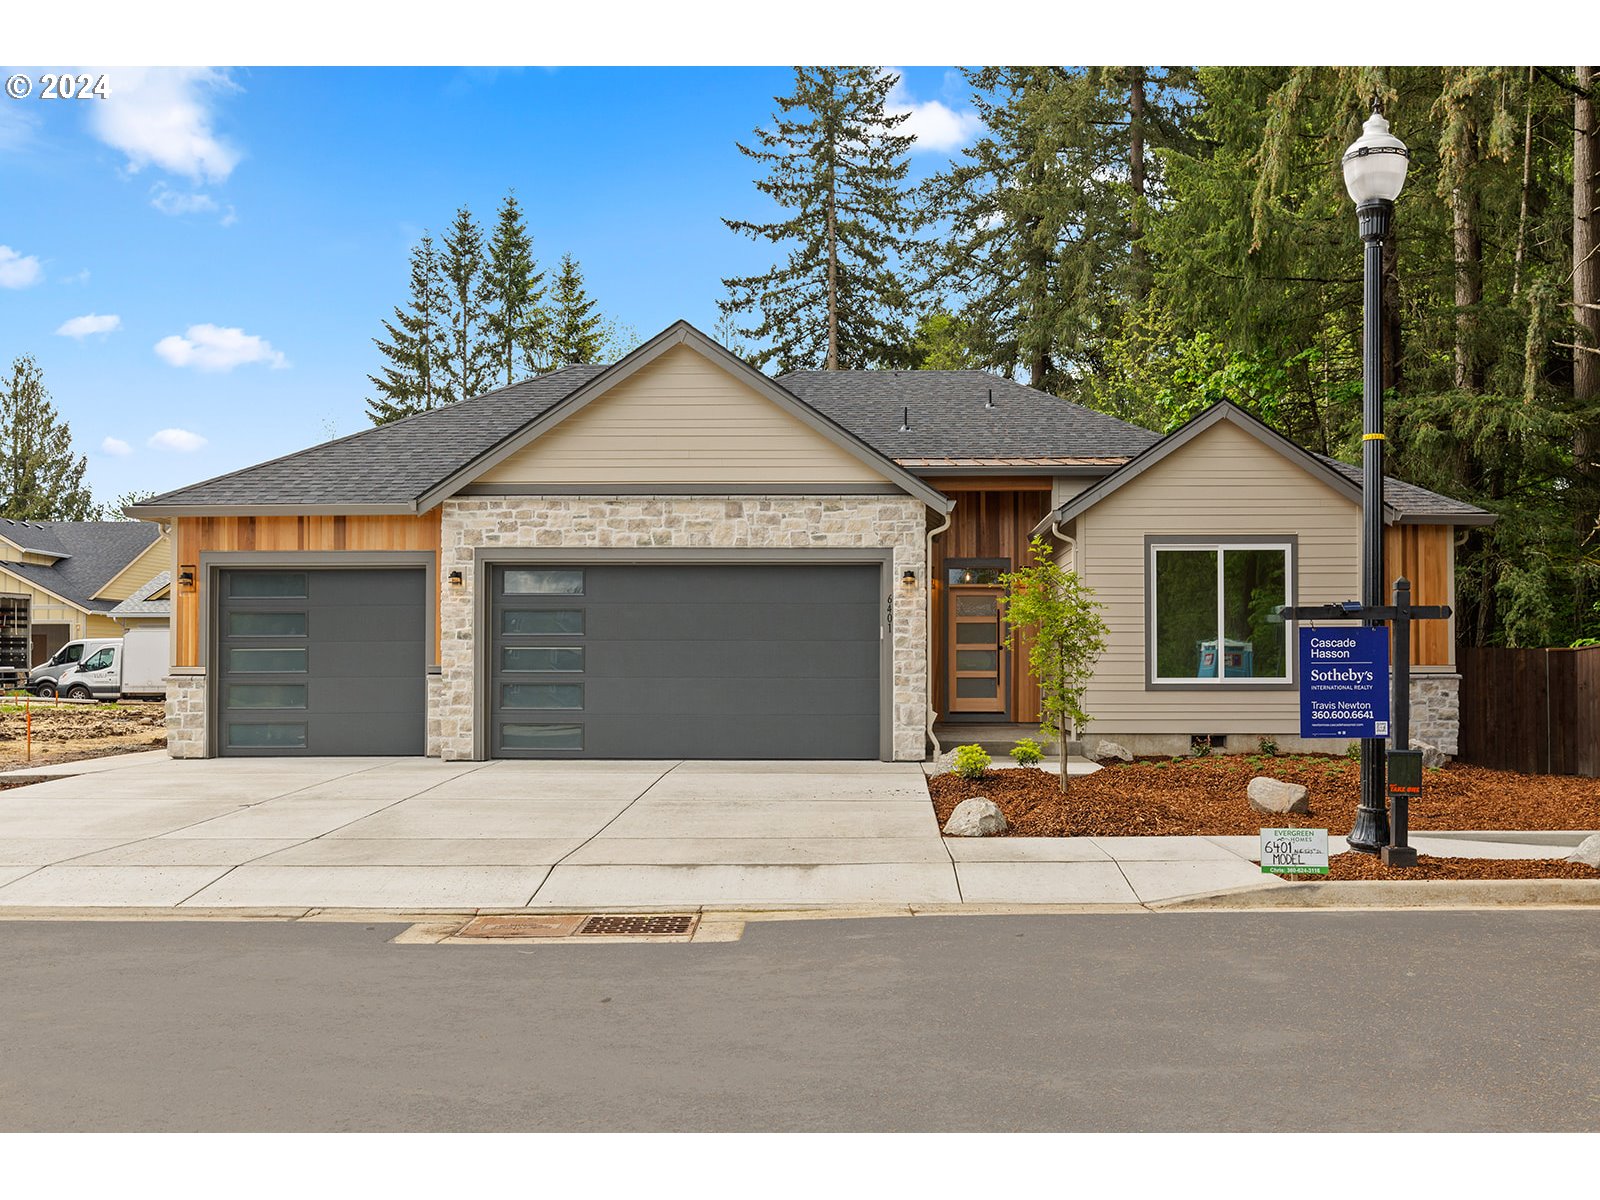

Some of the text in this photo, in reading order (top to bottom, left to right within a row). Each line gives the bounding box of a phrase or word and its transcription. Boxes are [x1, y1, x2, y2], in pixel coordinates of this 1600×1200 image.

[1311, 638, 1356, 648] Cascade
[1311, 648, 1350, 658] Hasson
[1311, 668, 1374, 683] Sotheby's
[1311, 701, 1371, 710] Travis Newton
[1311, 710, 1374, 719] 360.600.6641
[1264, 841, 1292, 854] 6401
[1272, 853, 1306, 865] MODEL
